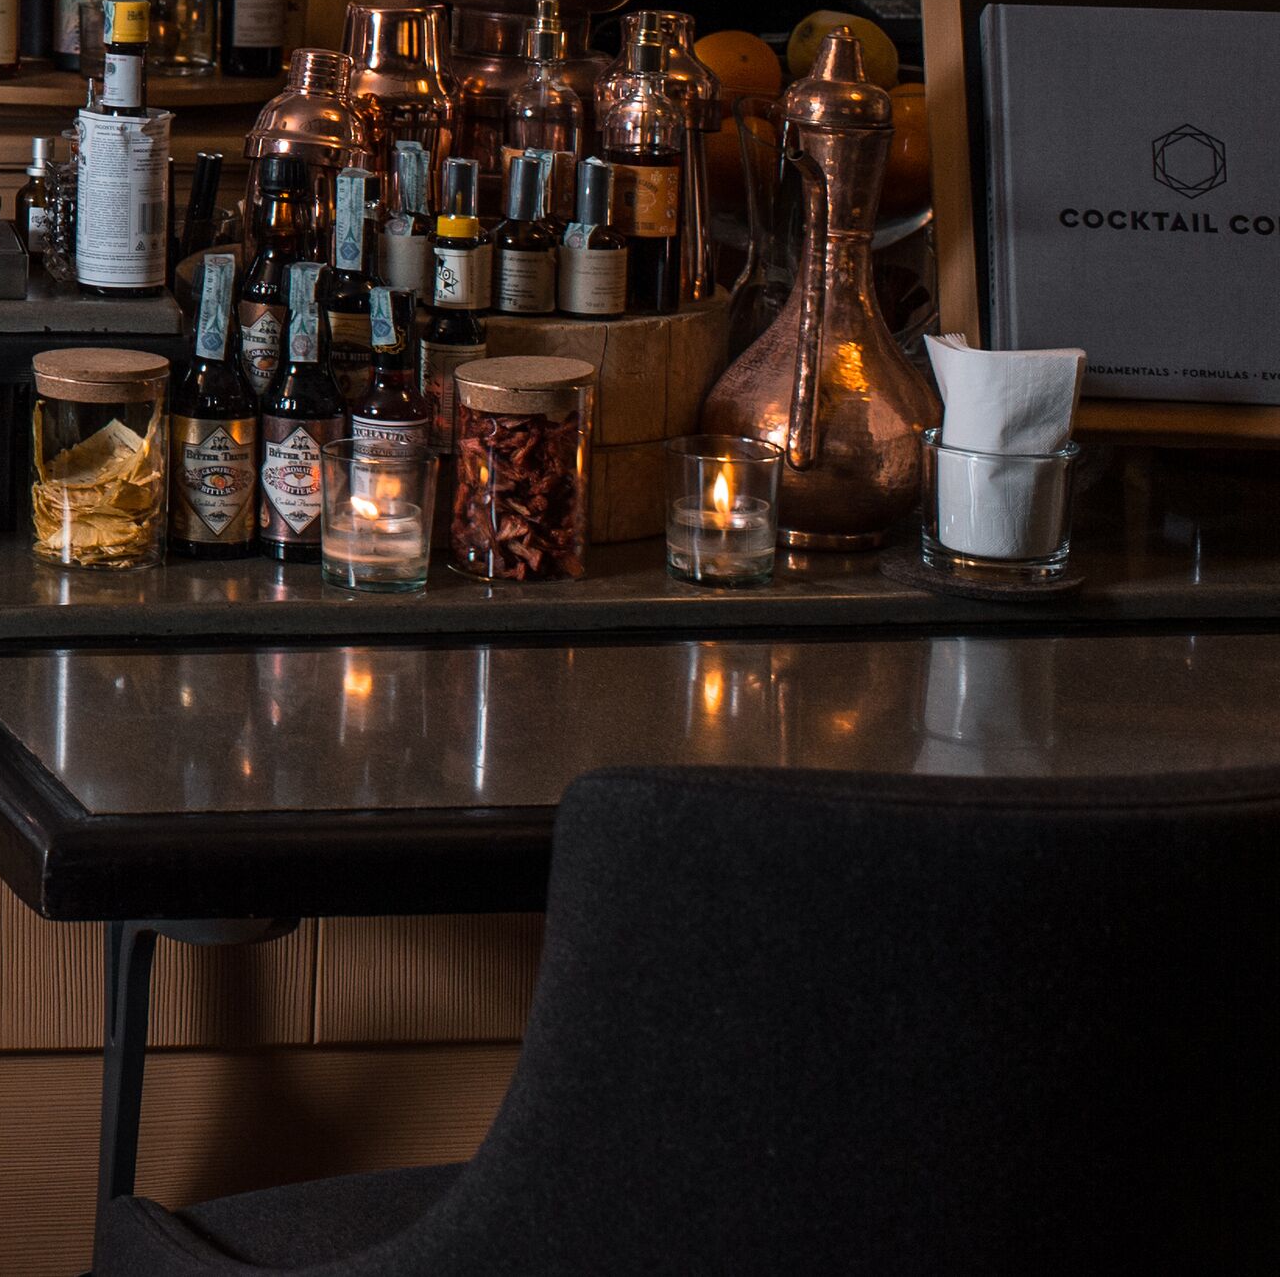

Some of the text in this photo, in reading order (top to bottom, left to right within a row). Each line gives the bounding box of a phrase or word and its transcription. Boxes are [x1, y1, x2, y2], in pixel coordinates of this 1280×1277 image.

[1059, 208, 1280, 236] COCKTAIL CO
[1085, 365, 1170, 377] NDAMENTALS
[1183, 369, 1249, 380] FORMULAS
[269, 447, 299, 460] BITTER
[200, 485, 237, 495] BITTERS
